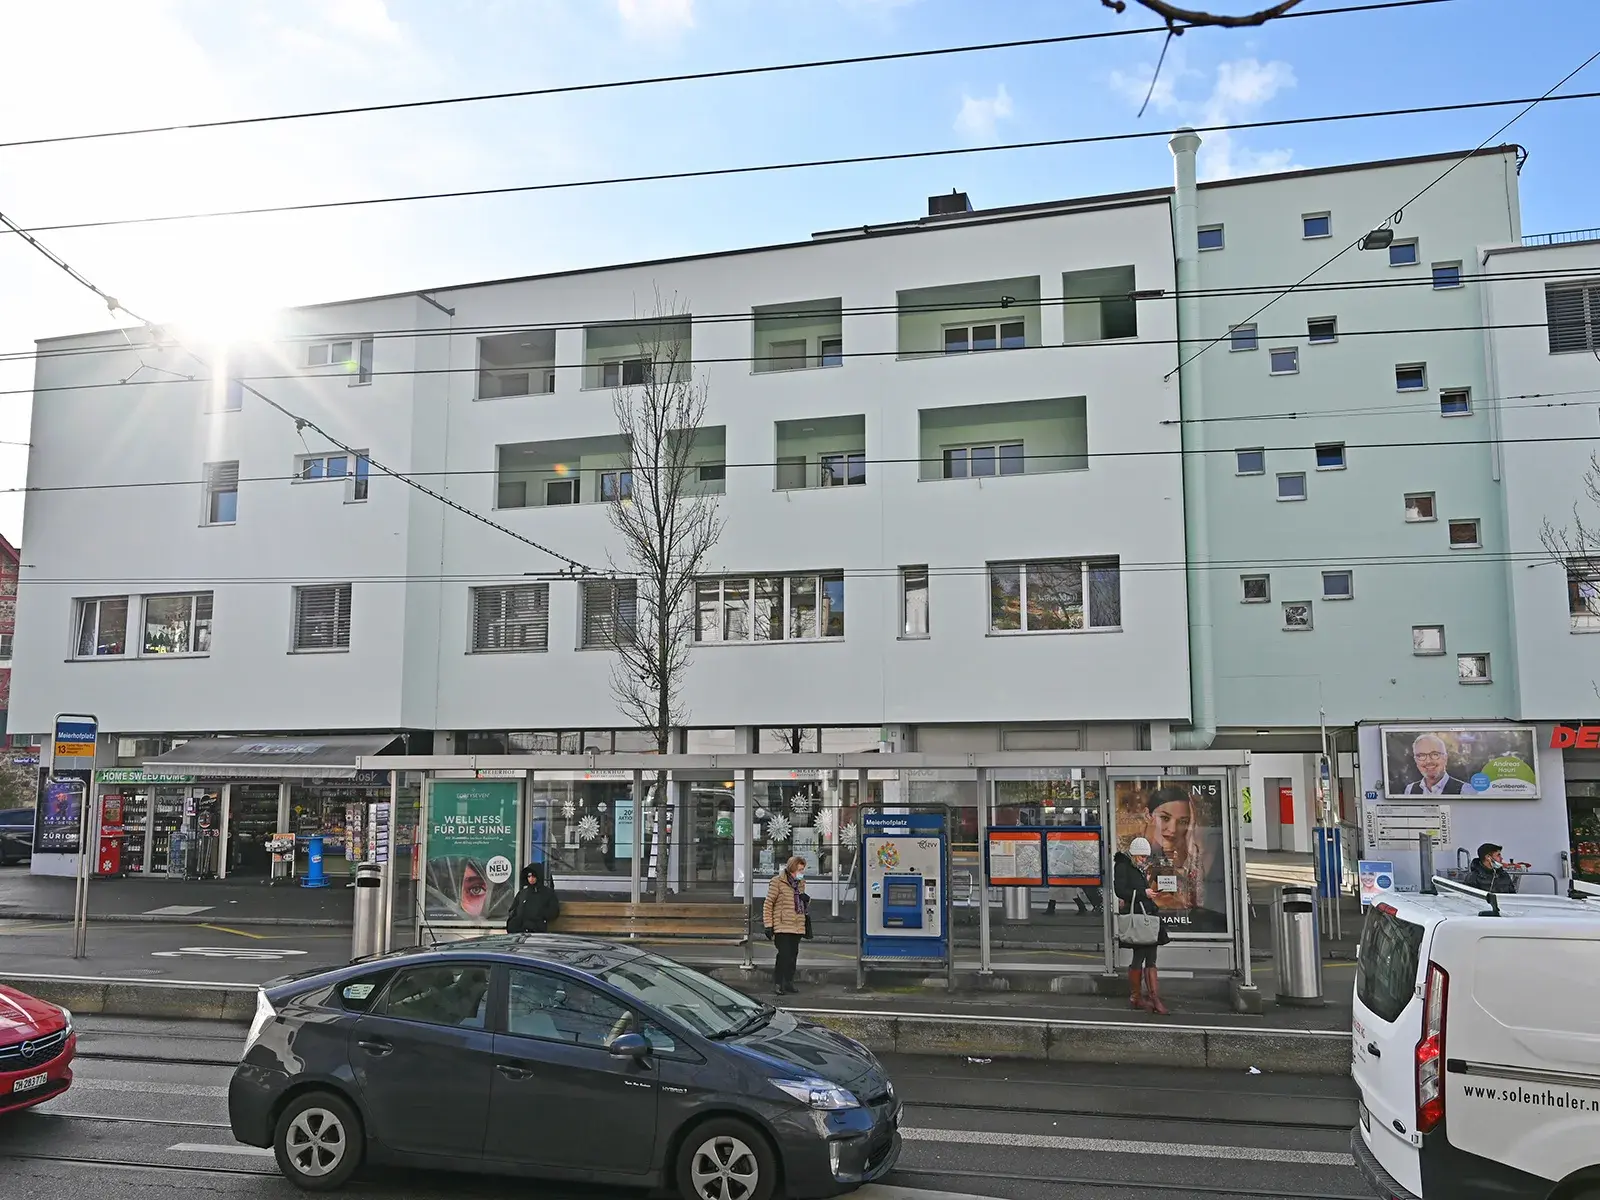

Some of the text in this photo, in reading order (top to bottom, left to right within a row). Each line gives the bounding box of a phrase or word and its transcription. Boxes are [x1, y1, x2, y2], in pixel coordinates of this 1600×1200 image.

[58, 732, 95, 740] Meierhofplatz
[1549, 726, 1600, 749] DE
[58, 745, 66, 754] 13
[103, 772, 127, 780] HOME
[129, 772, 158, 780] SWEED
[444, 815, 501, 824] WELLNESS
[434, 824, 511, 834] FÜR DIE SINNE
[489, 864, 509, 873] NEU
[1160, 916, 1192, 924] HANEL
